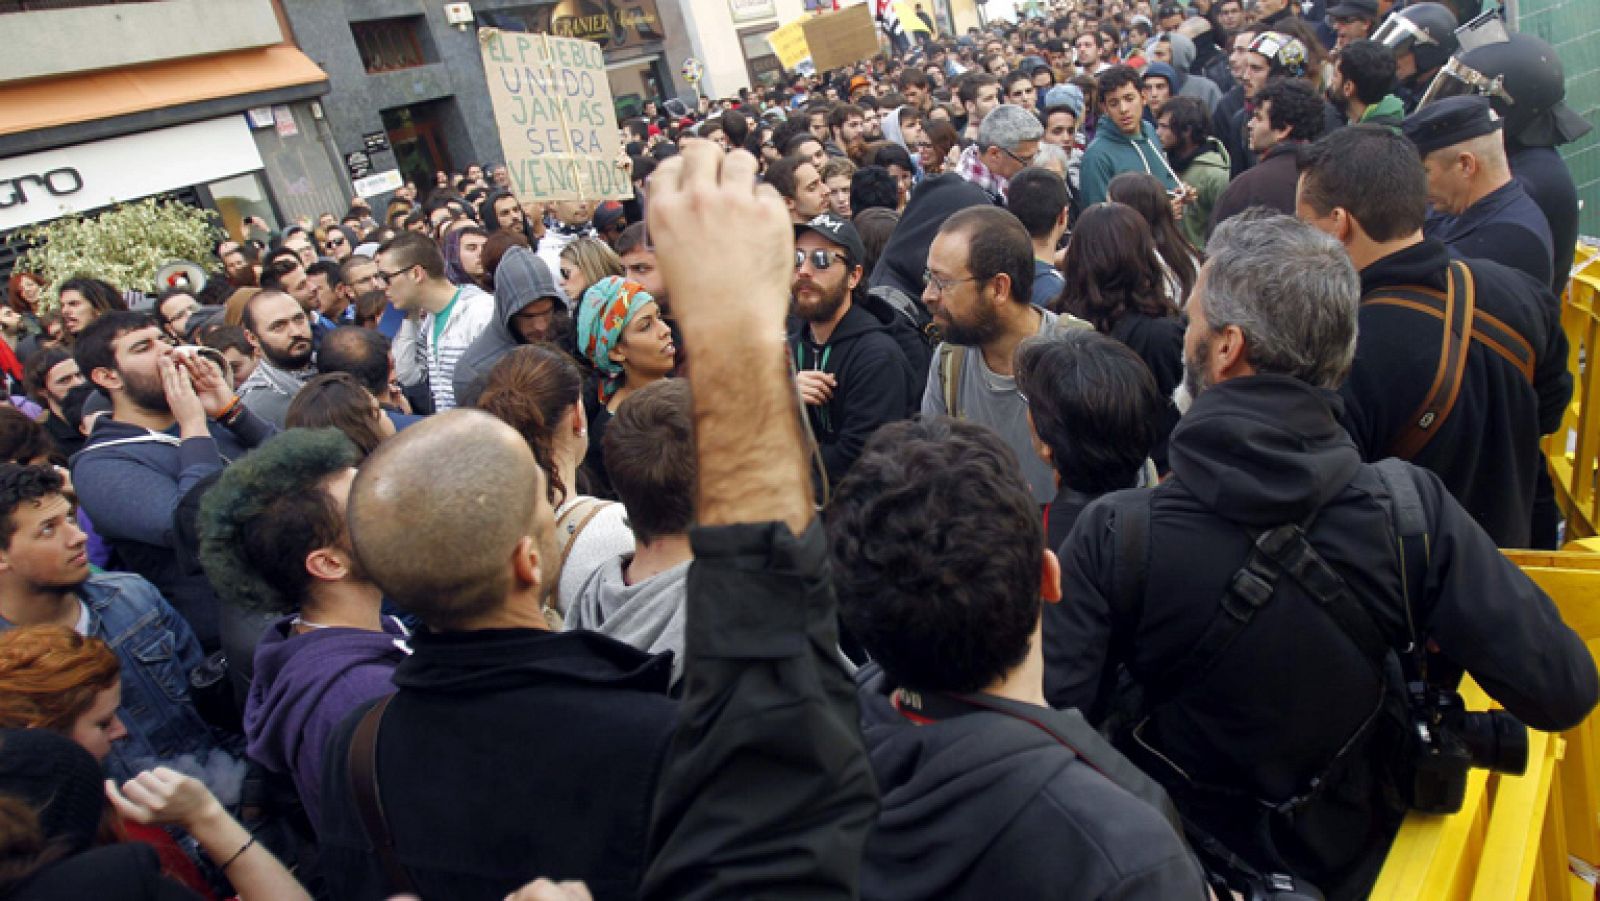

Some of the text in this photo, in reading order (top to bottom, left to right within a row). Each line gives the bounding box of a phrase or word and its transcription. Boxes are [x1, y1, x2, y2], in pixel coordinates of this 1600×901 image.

[488, 35, 512, 62] EL
[501, 66, 595, 98] UNIDO
[508, 157, 628, 197] VENCIDO
